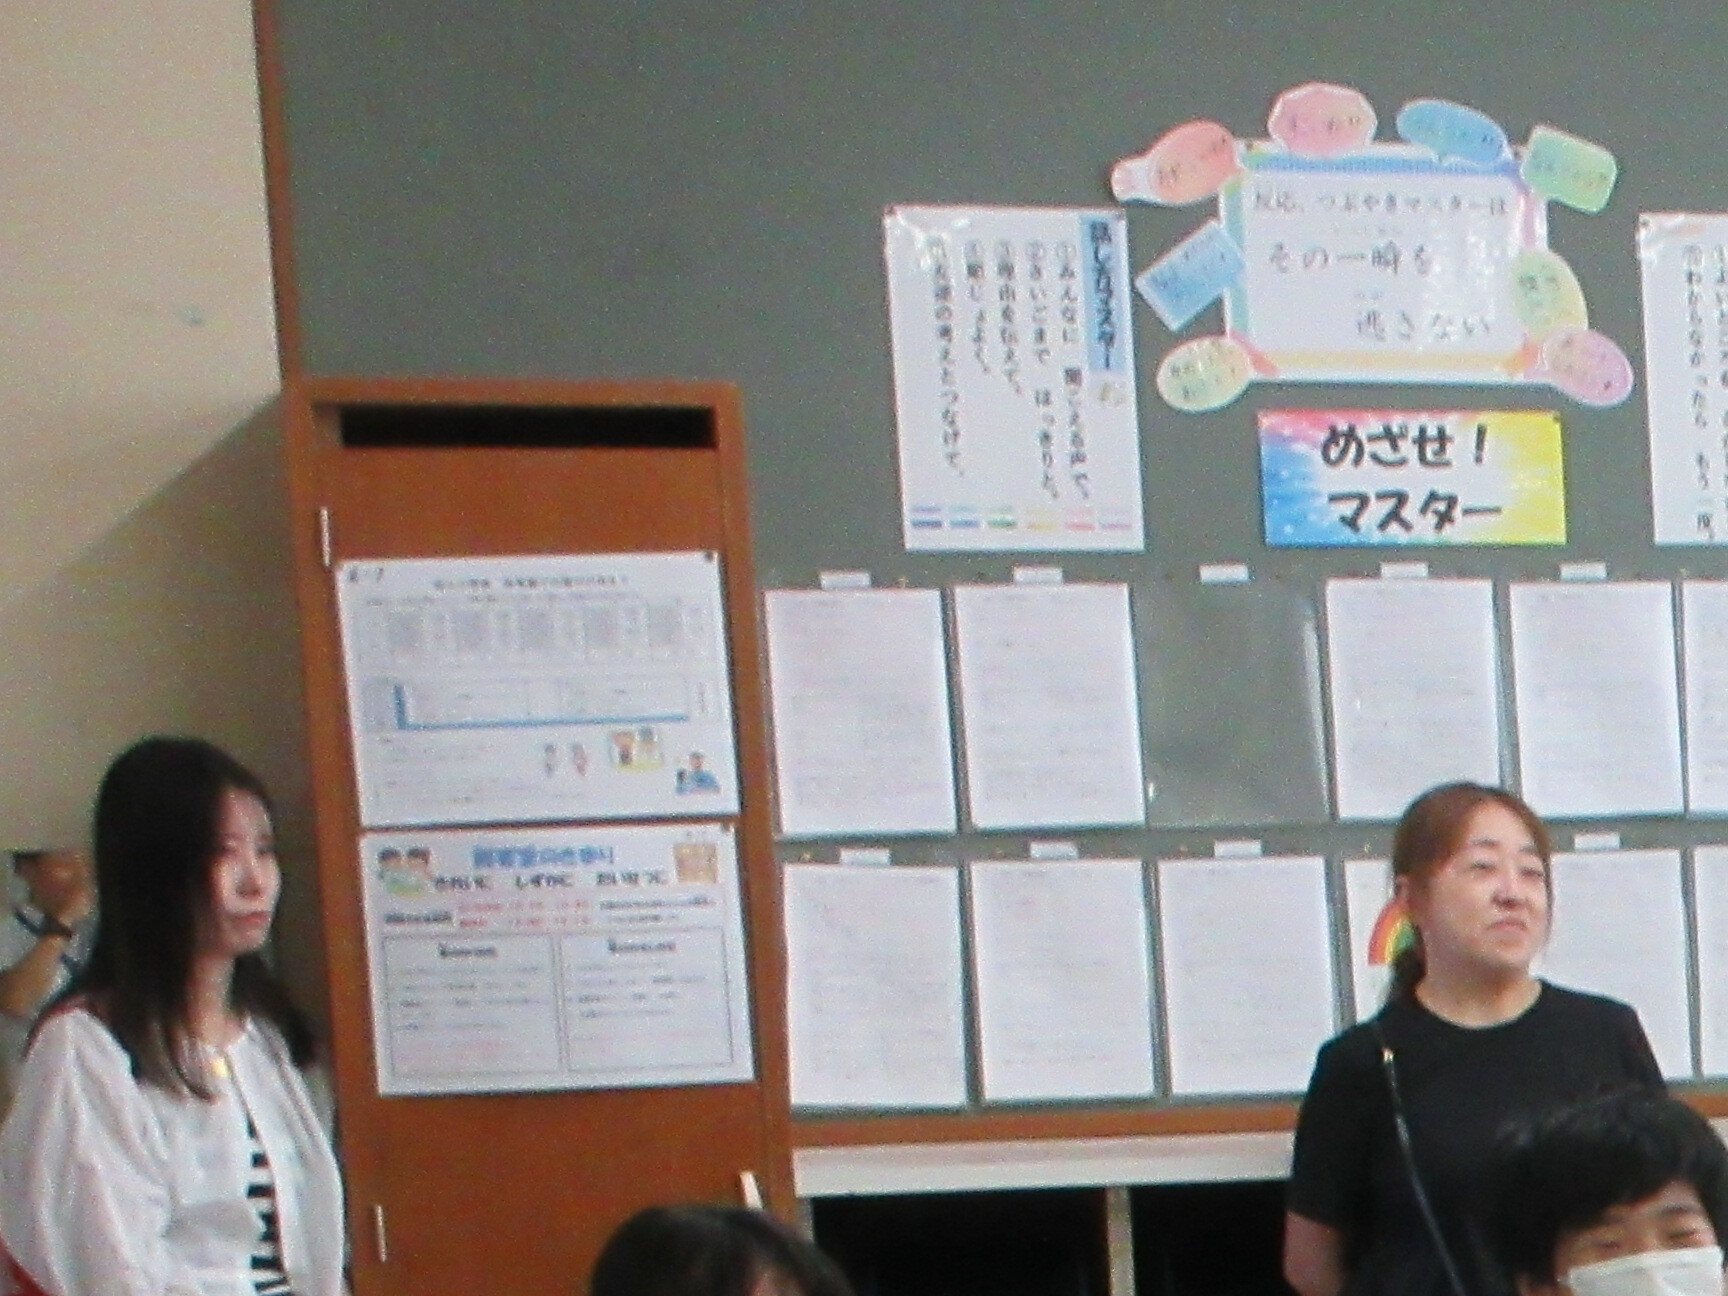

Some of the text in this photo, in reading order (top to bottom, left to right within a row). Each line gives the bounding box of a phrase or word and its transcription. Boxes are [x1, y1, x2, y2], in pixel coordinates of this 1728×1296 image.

[1268, 241, 1432, 278] その一瞬を
[1320, 421, 1489, 468] めざせ！
[1327, 488, 1503, 533] マスター
